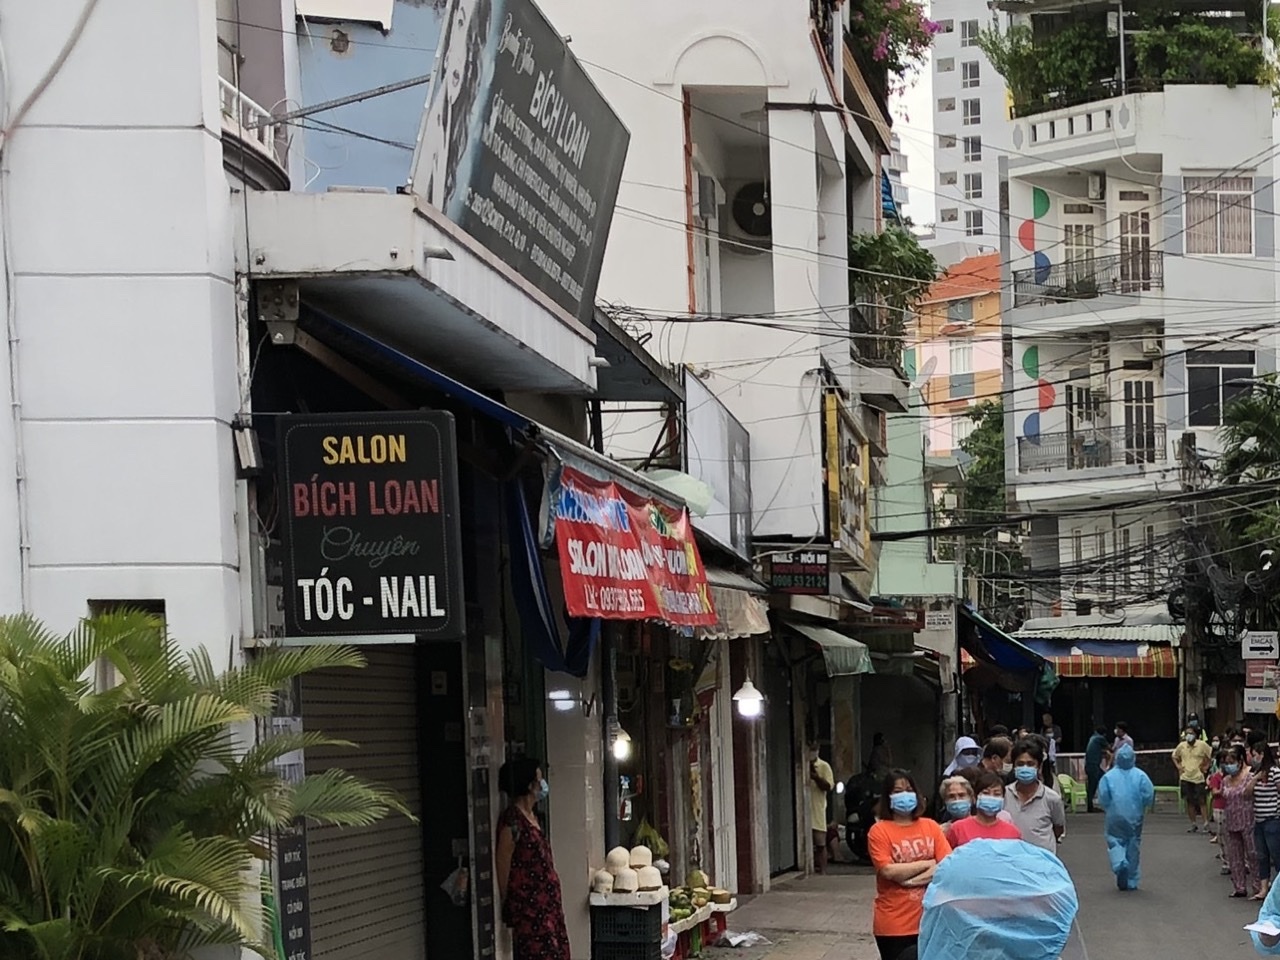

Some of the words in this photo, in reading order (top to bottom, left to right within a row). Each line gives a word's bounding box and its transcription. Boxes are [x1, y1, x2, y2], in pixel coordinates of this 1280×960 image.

[529, 70, 565, 134] BÍCH
[556, 107, 590, 170] LOAN
[322, 435, 407, 465] SALON
[293, 473, 357, 517] BÍCH
[369, 479, 440, 515] LOAN
[320, 525, 420, 569] Chuyên
[297, 566, 354, 621] TÓC
[379, 575, 446, 618] NAIL
